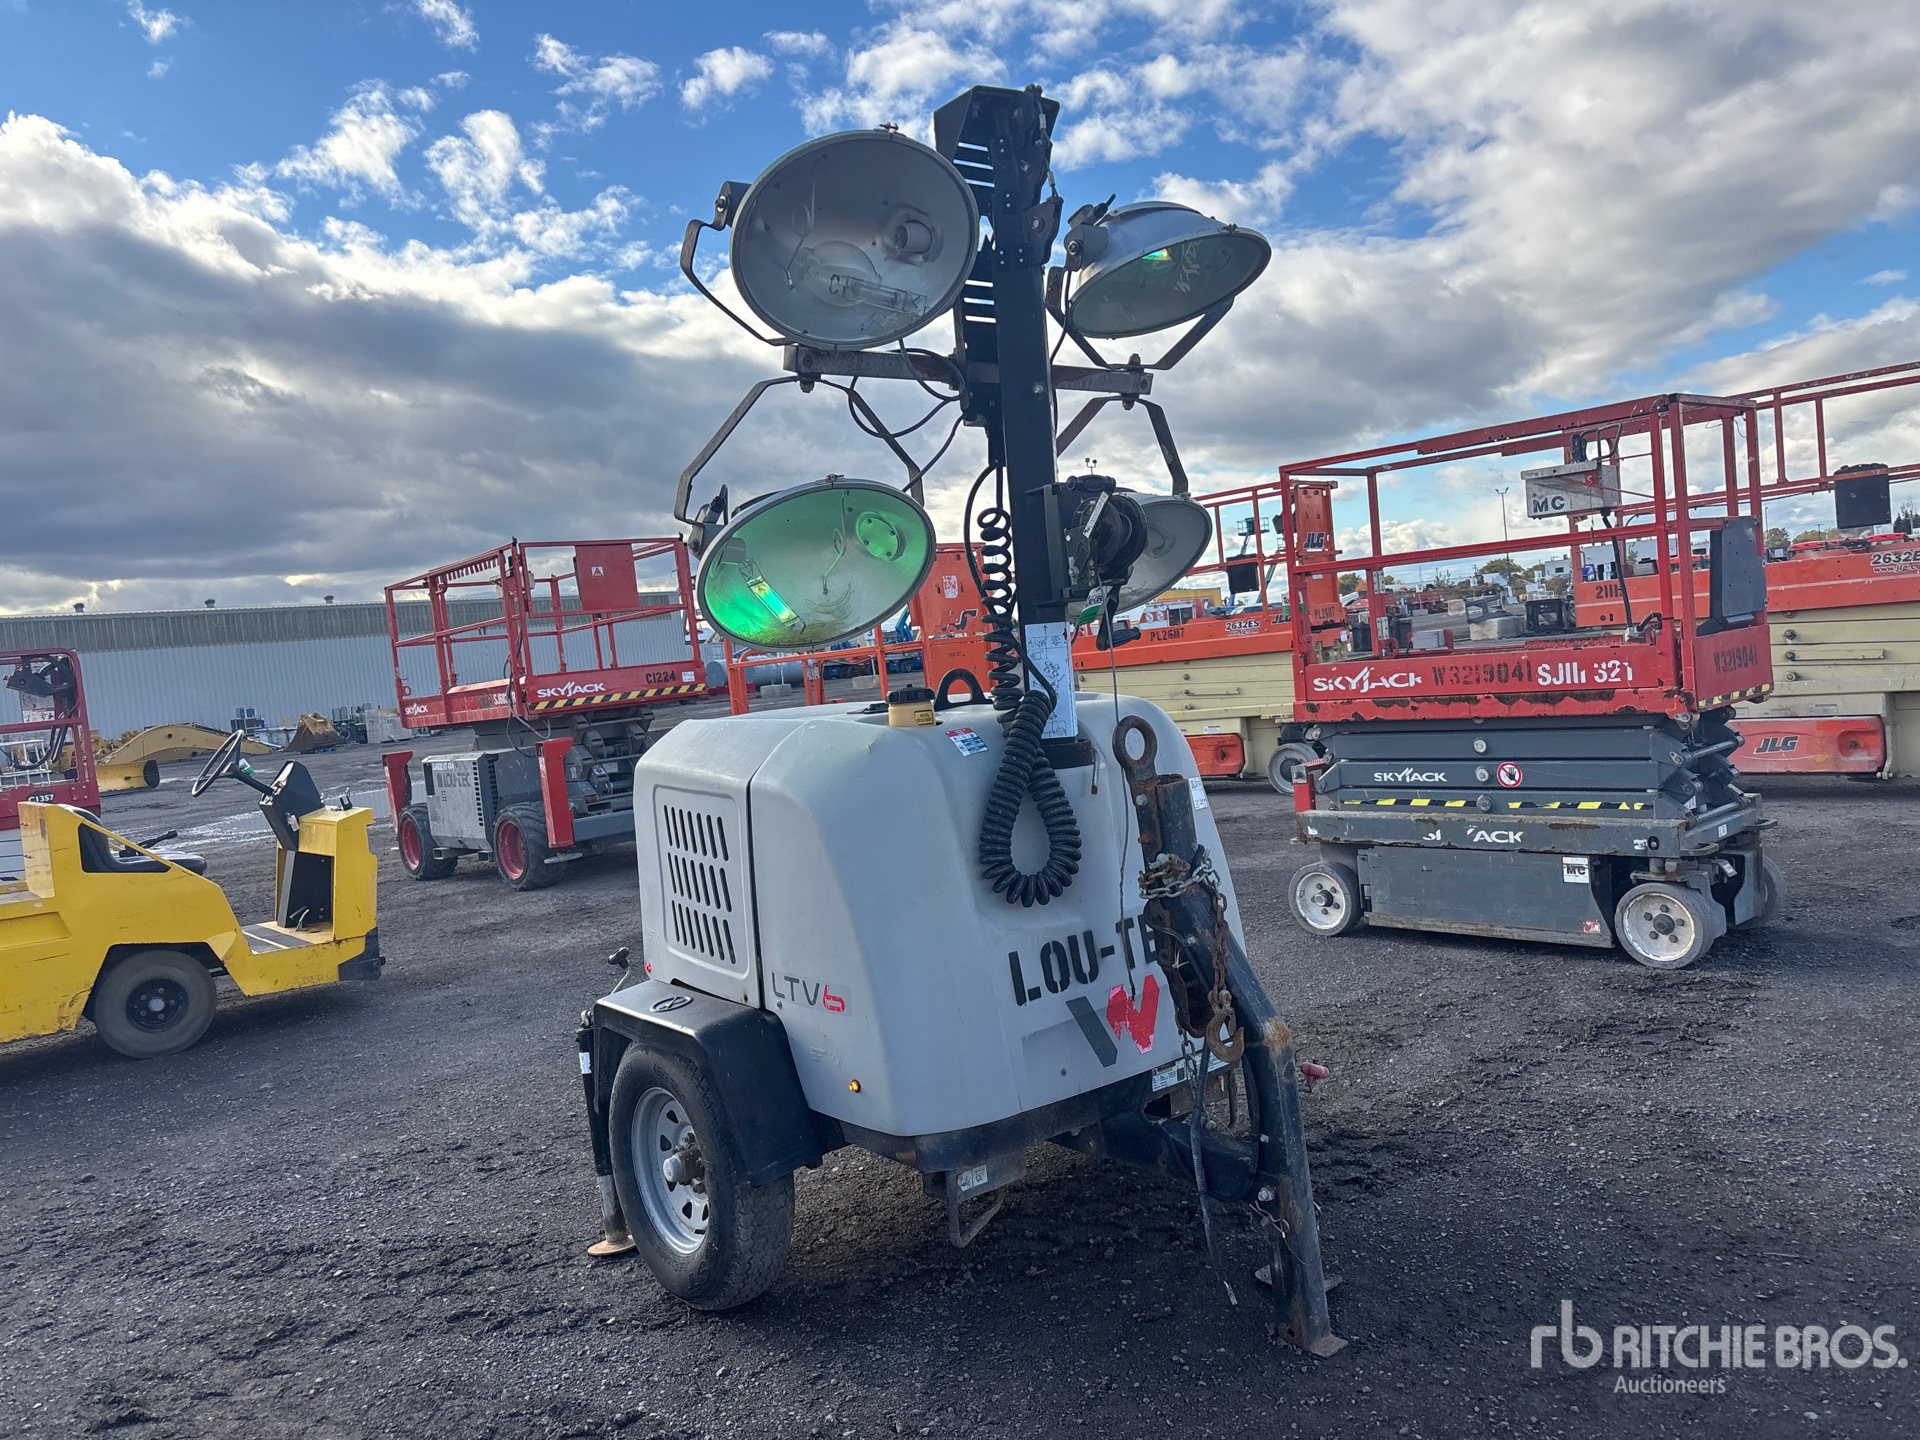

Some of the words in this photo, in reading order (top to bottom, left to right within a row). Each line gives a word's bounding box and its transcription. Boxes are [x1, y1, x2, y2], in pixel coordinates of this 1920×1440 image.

[1532, 496, 1565, 513] MC
[1303, 532, 1325, 549] JLG
[1871, 550, 1920, 566] 2632E
[1873, 563, 1920, 573] www.jlg.co
[1225, 619, 1260, 631] 2632ES
[645, 670, 676, 685] C1224
[536, 681, 606, 698] SKYJACK
[404, 702, 428, 716] SKYJACK
[1753, 735, 1799, 755] JLG
[1373, 767, 1447, 783] SKYJACK
[28, 793, 55, 803] C1357
[1566, 865, 1586, 875] MC
[1008, 914, 1157, 1007] LOU-TE
[771, 972, 845, 1012] LTV6
